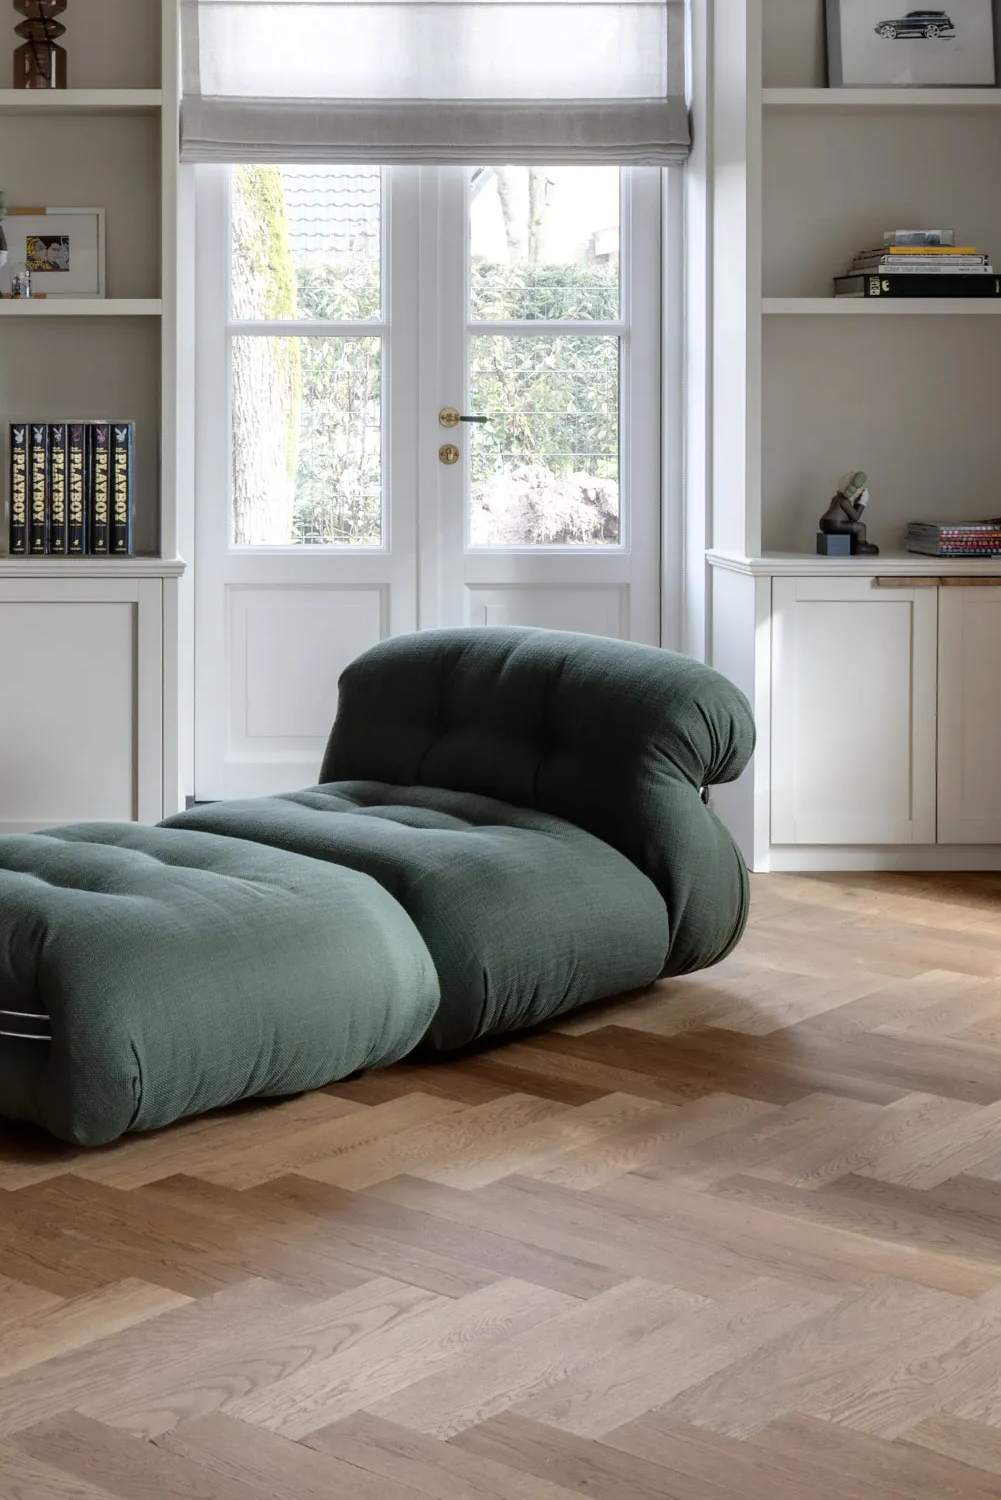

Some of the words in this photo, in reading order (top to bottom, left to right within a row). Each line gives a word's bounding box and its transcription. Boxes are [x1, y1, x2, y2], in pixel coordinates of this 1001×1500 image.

[13, 453, 25, 522] PLAYBOY
[33, 452, 45, 522] PLAYBOY
[52, 453, 64, 522] PLAYBOY
[70, 453, 82, 522] PLAYBOY
[95, 454, 107, 522] PLAYBOY
[115, 454, 127, 522] PLAYBOY
